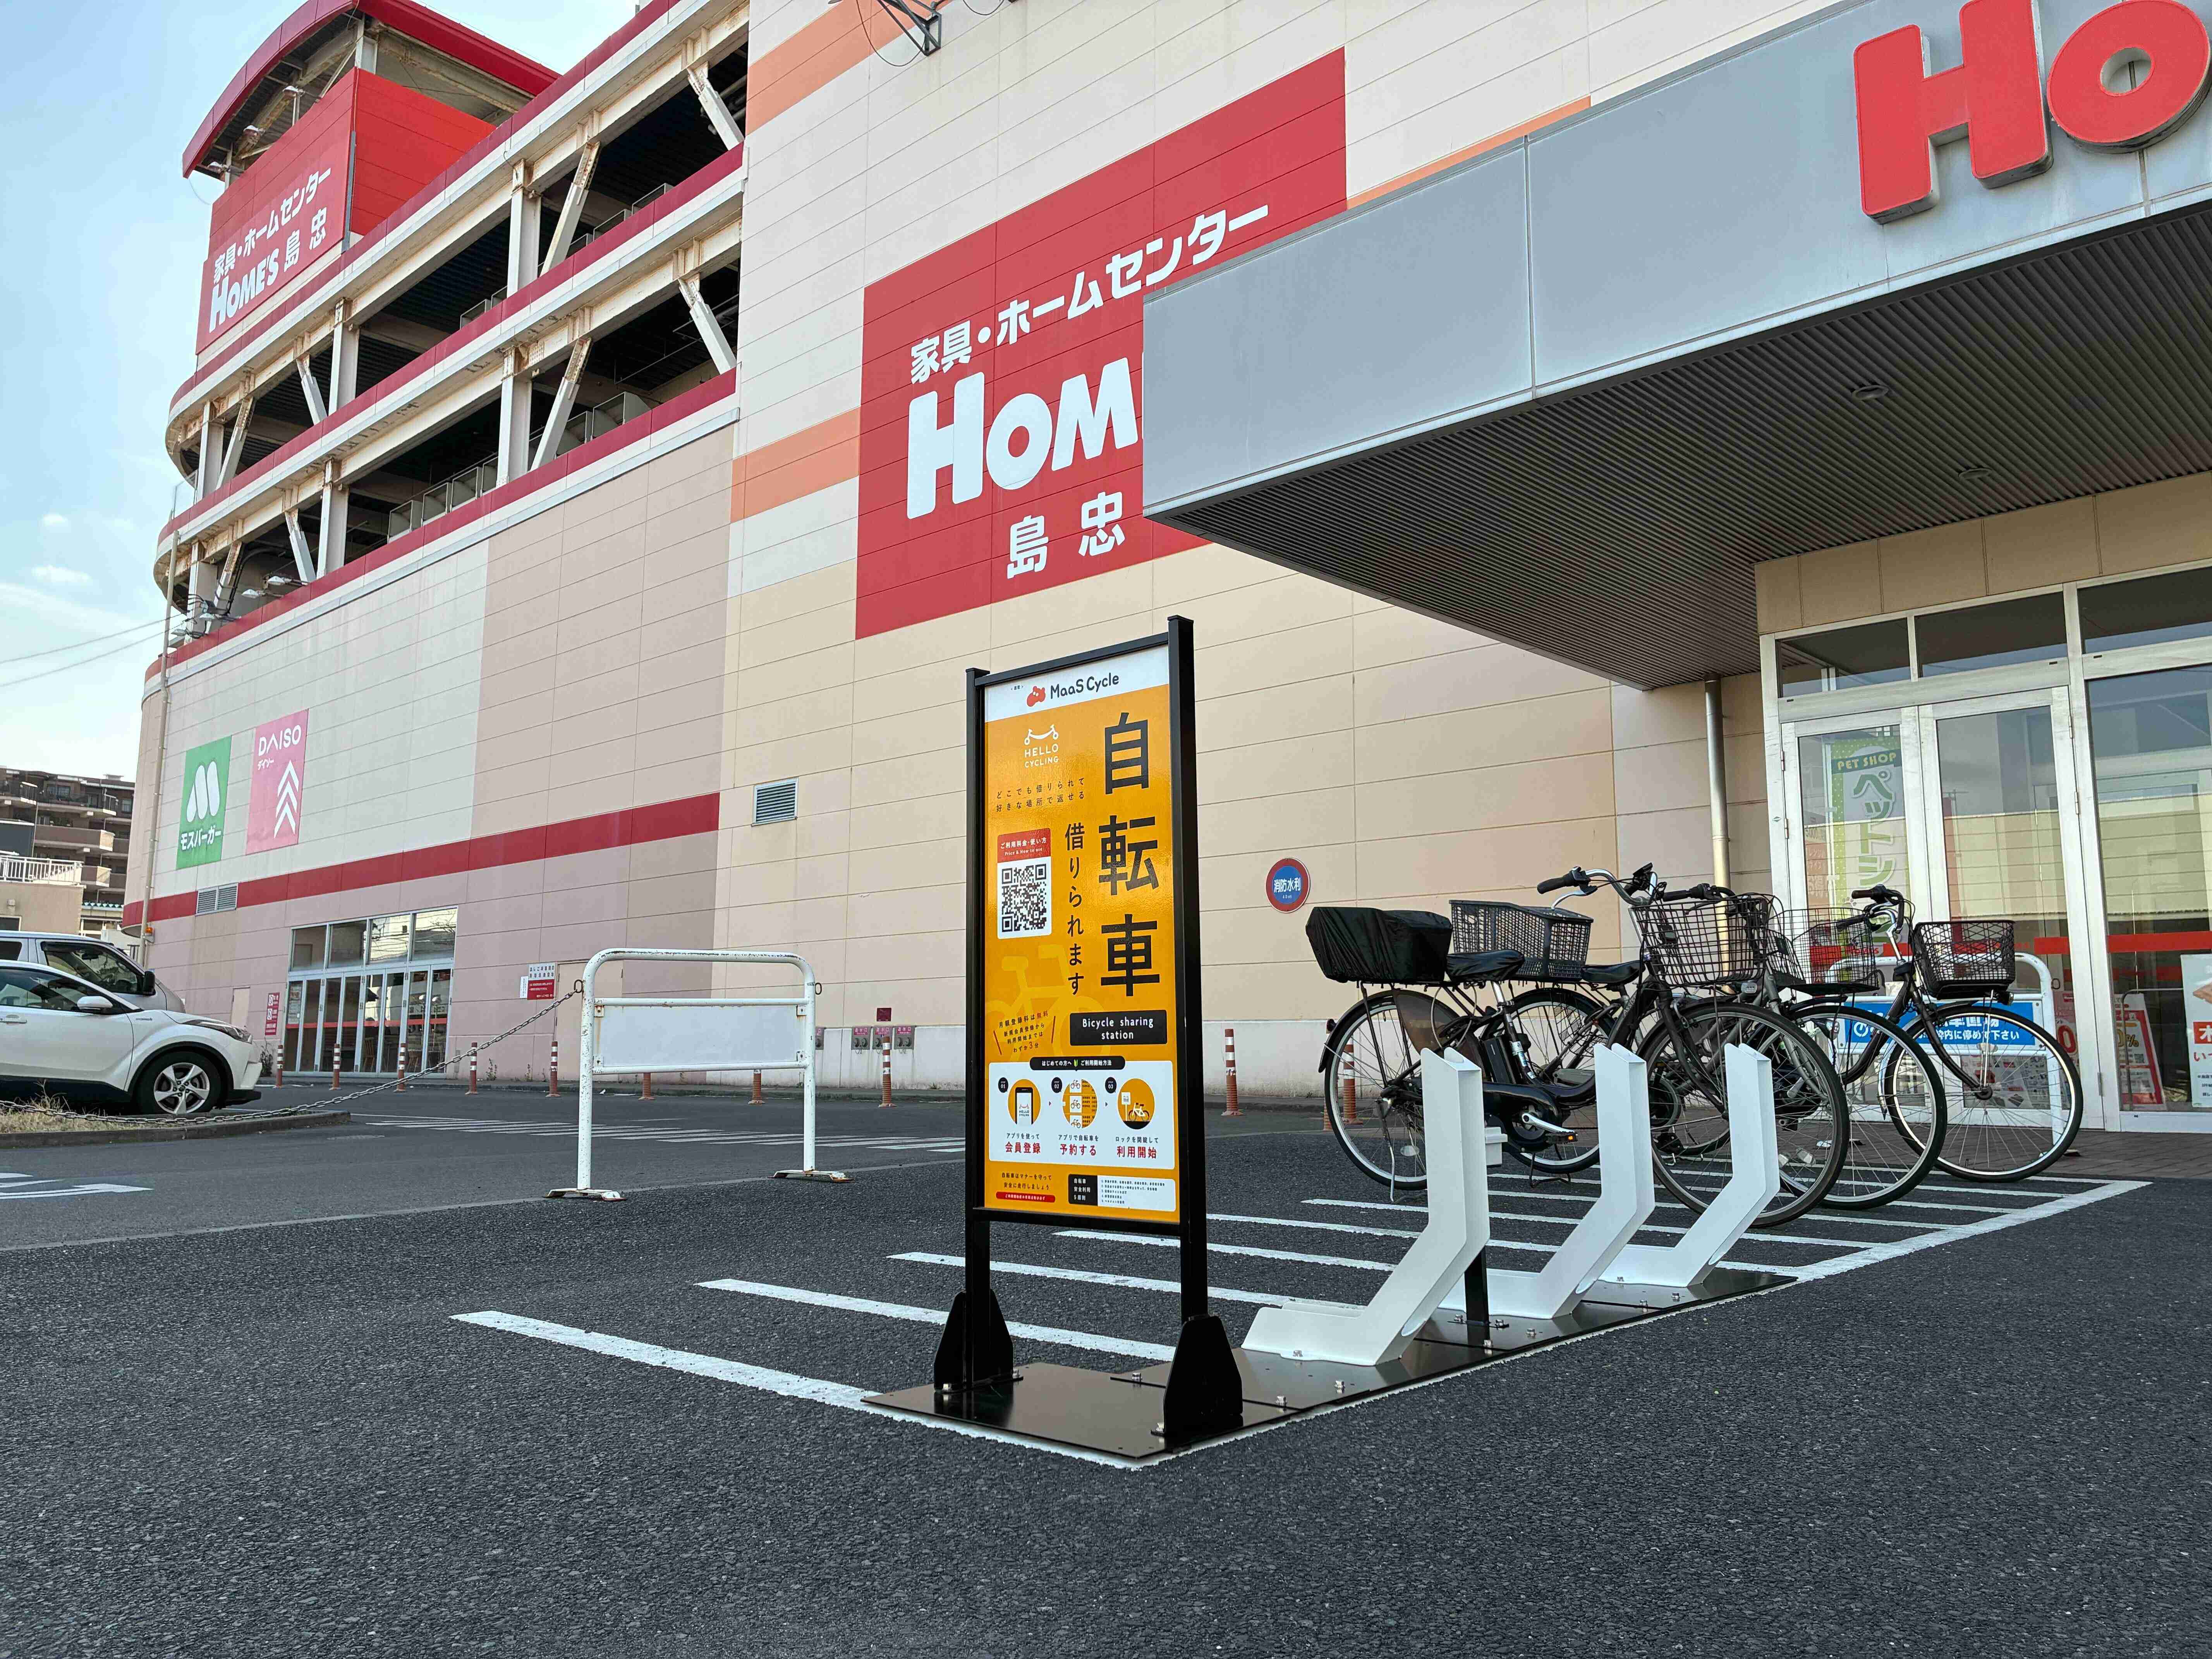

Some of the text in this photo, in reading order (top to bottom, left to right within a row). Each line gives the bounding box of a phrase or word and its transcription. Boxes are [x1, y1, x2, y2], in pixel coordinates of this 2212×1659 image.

[214, 167, 331, 285] 家具・ホームセンター
[910, 204, 1269, 385] 家具・ホームセンター
[907, 356, 1143, 520] HOM
[1007, 491, 1125, 579] 島忠
[1051, 672, 1119, 699] MaaS Cycle
[258, 725, 301, 756] DAISO
[1024, 744, 1059, 758] HELLO
[1025, 756, 1059, 768] CYCLING
[1837, 752, 1896, 770] PET SHOP
[997, 777, 1085, 799] どこでも借りられて
[996, 791, 1084, 812] 好きな場所で返せる
[180, 825, 222, 850] モスバーガー
[1098, 712, 1160, 997] 自転車
[1274, 877, 1301, 893] 消防水利
[1065, 822, 1085, 995] 借りられます
[1082, 1017, 1154, 1029] Bicycle sharing
[1101, 1030, 1134, 1040] station
[1005, 1141, 1041, 1154] 会員登録
[1060, 1144, 1097, 1156] 予約する
[1117, 1146, 1157, 1159] 利用開始
